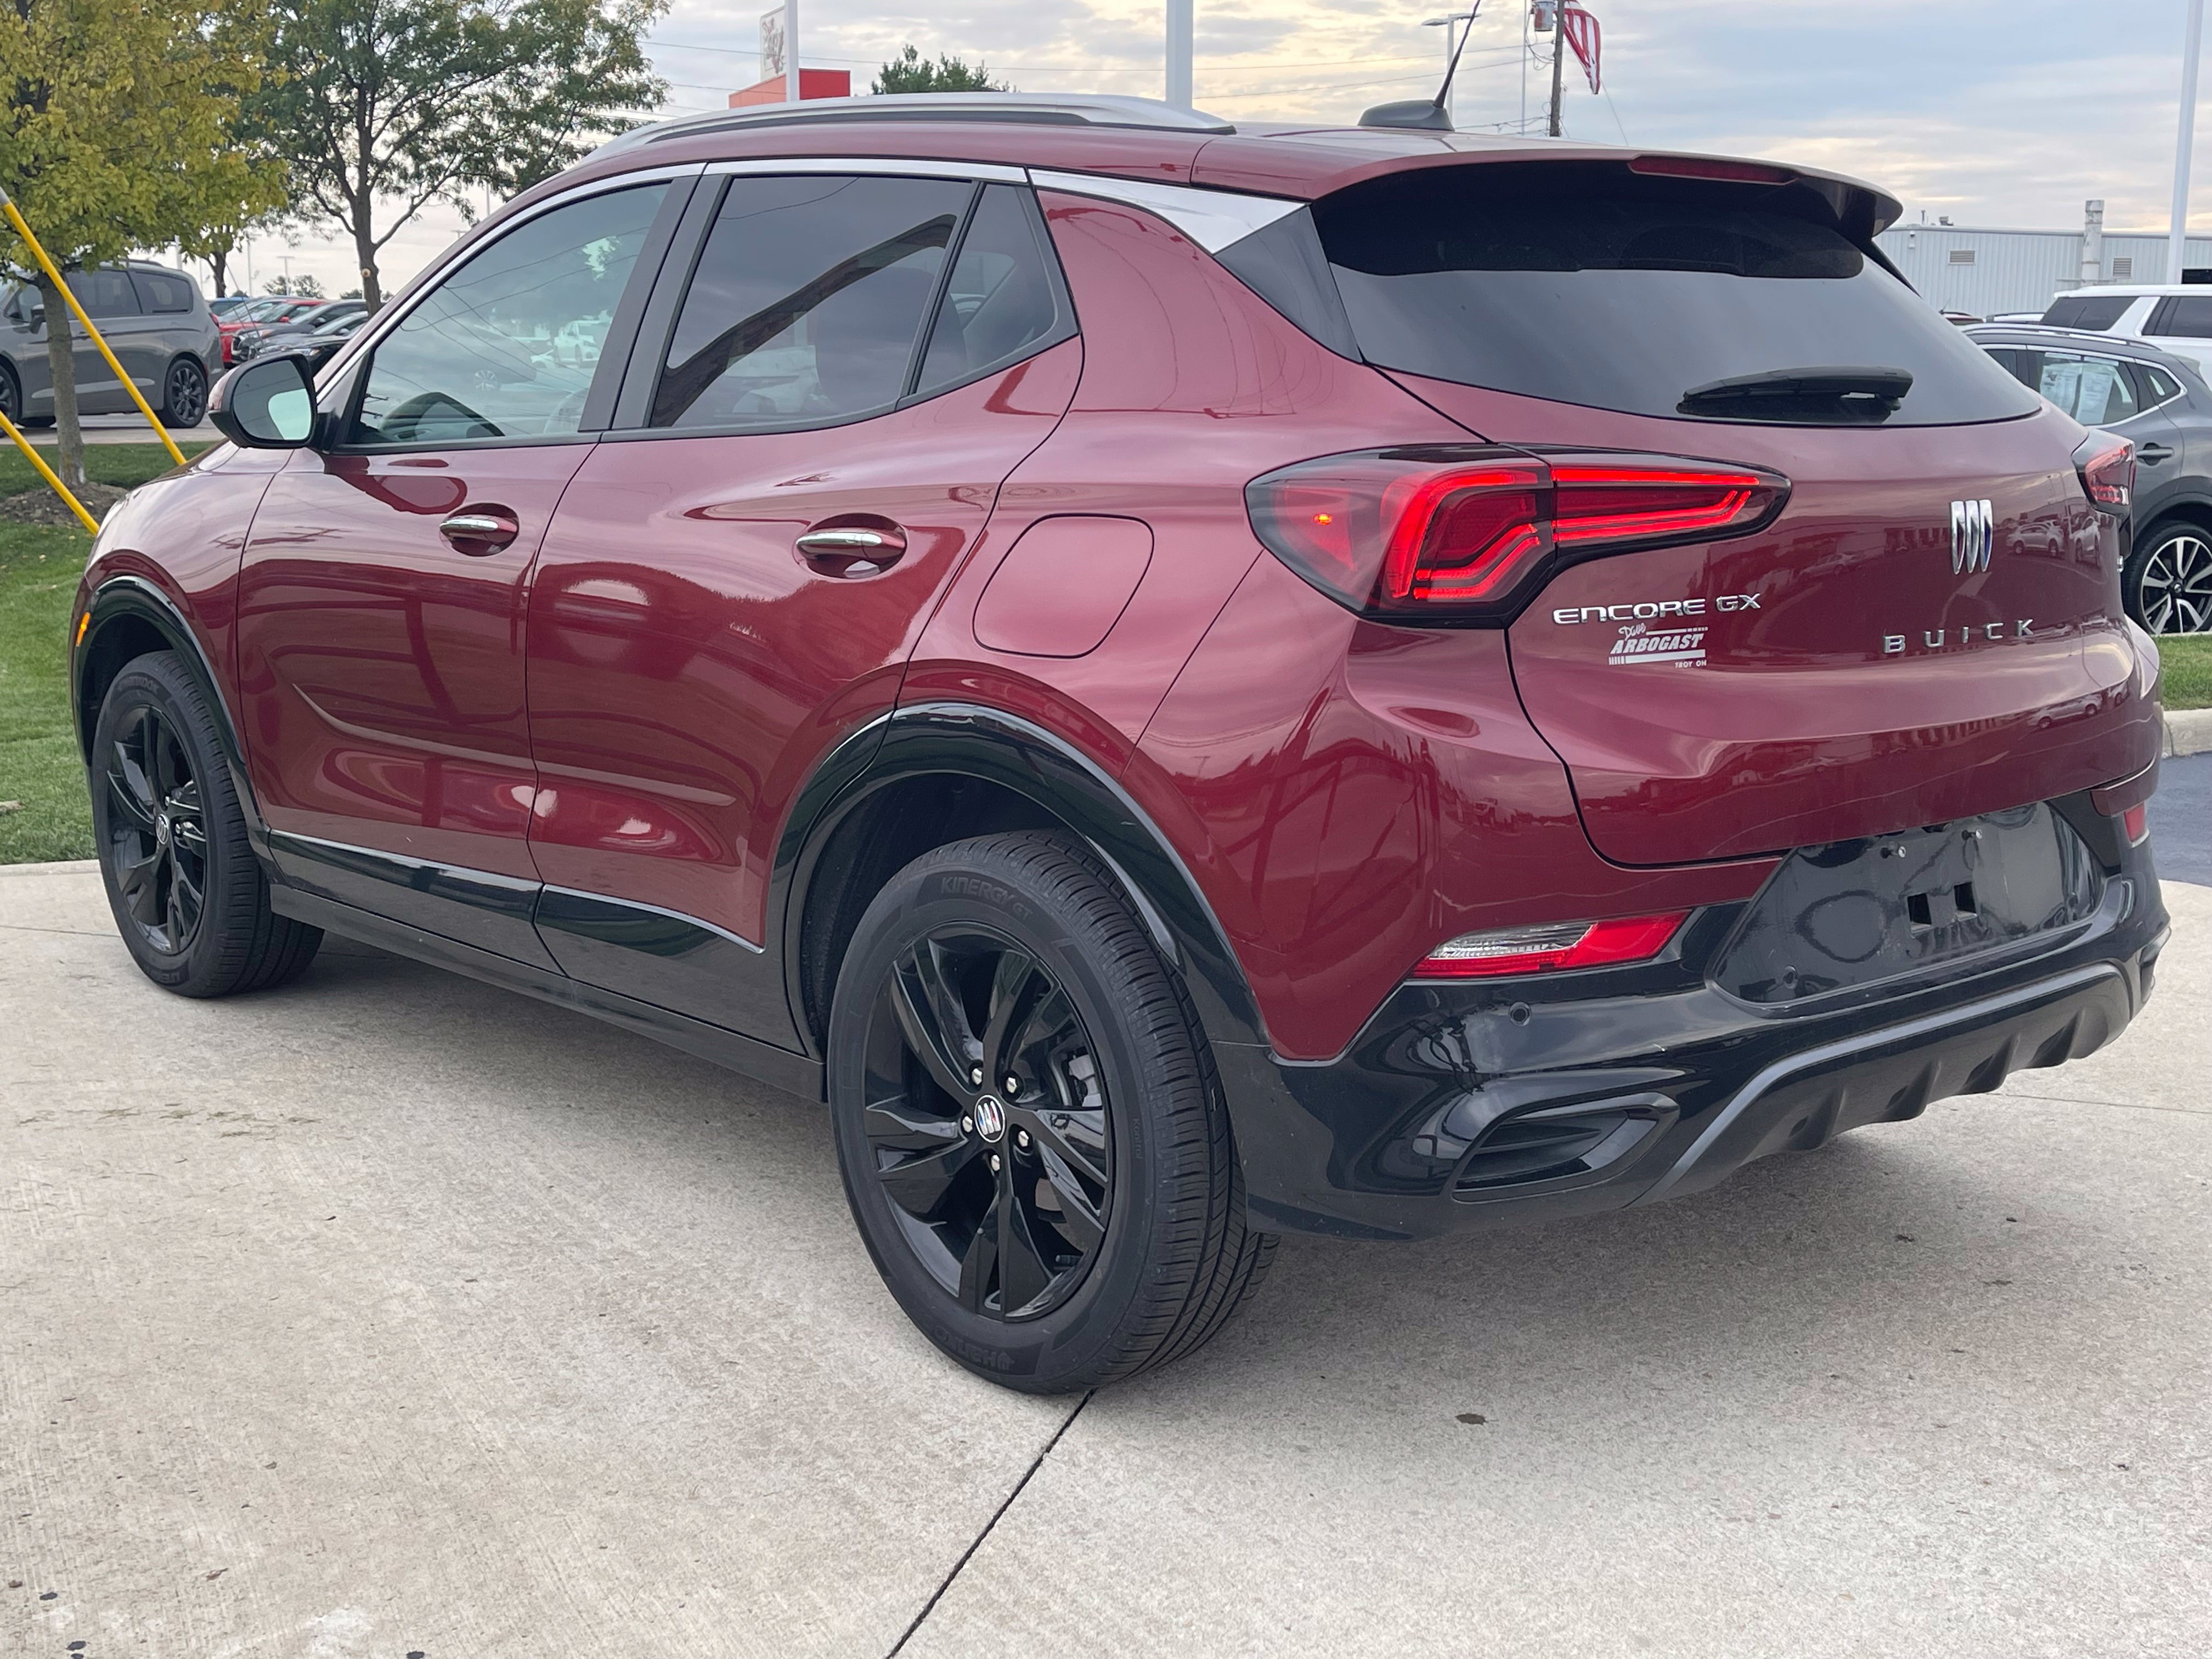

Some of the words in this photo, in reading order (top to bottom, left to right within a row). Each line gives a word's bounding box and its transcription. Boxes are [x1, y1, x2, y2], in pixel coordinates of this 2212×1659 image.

[1553, 599, 1706, 625] ENCORE
[1716, 593, 1761, 612] GX
[1610, 634, 1705, 654] ARBOGAST
[1618, 622, 1646, 641] Dave
[1884, 619, 2033, 653] BUICK
[941, 876, 1015, 905] KINERGY
[1013, 902, 1032, 919] GT
